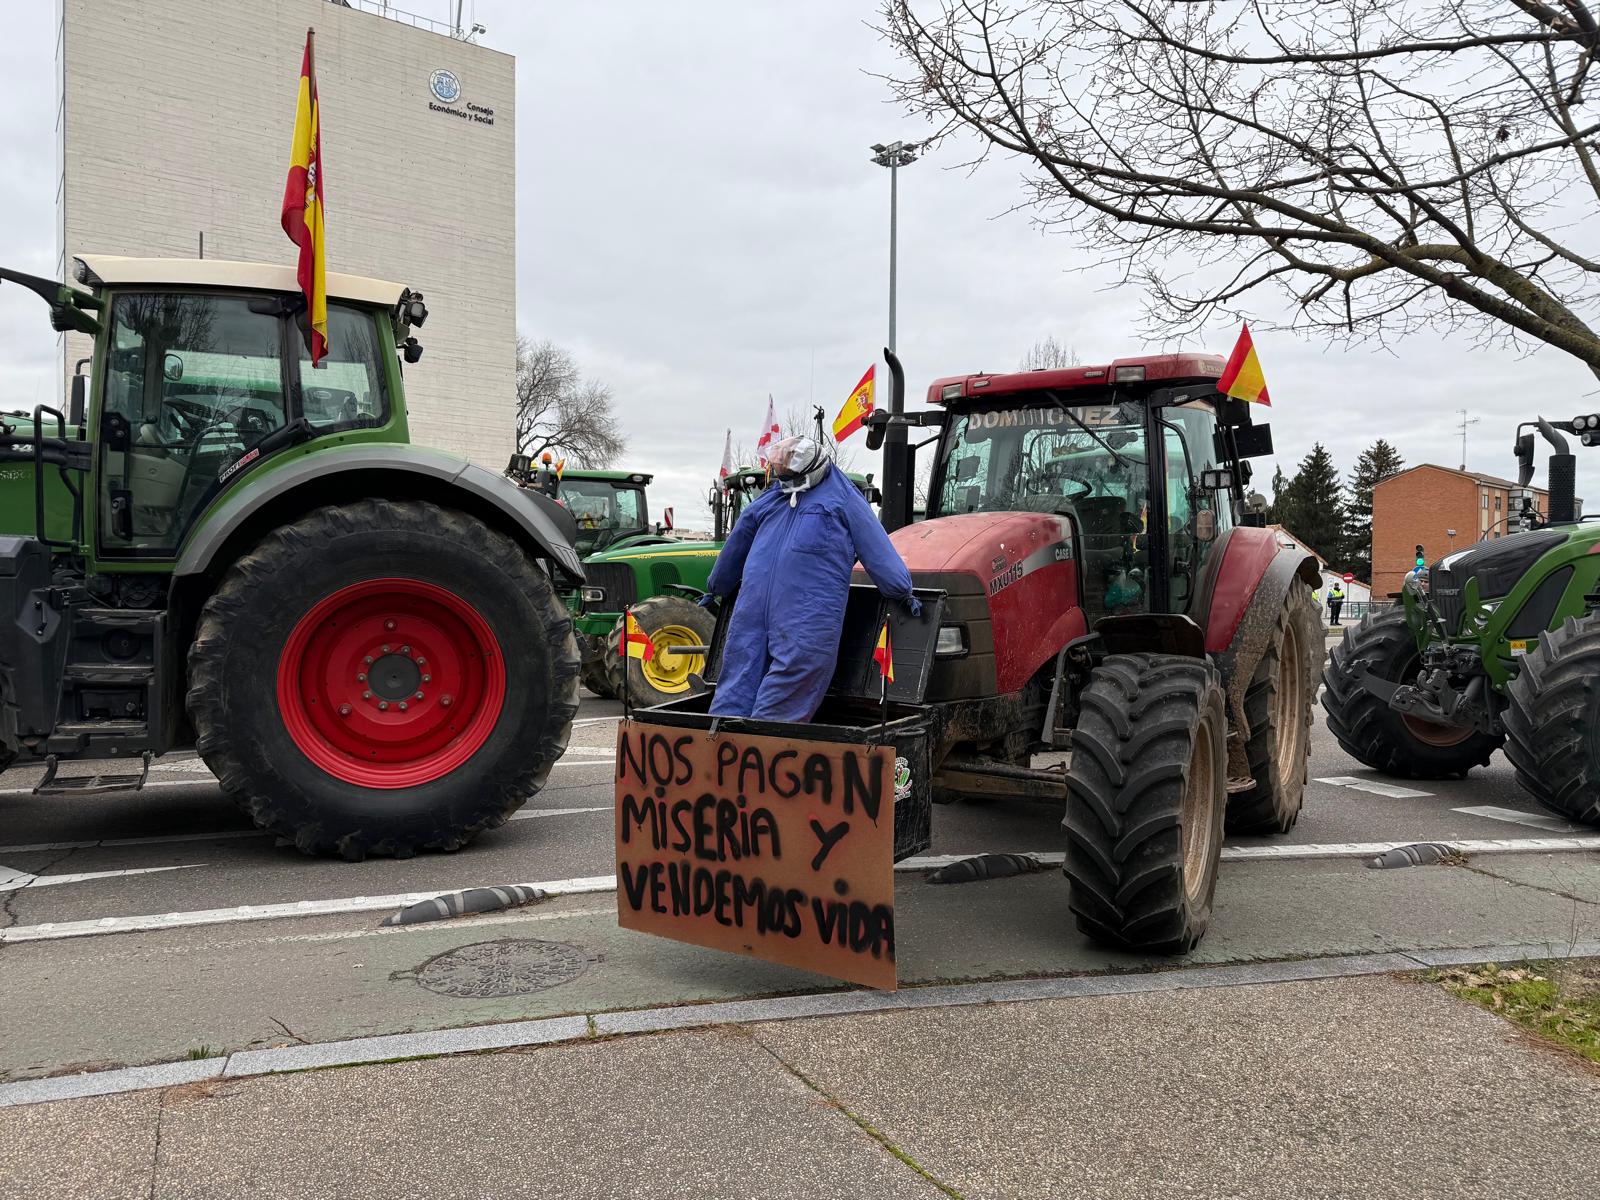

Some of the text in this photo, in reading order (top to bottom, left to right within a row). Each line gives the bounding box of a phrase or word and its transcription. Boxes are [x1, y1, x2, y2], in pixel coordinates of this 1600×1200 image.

[428, 102, 468, 119] Económico
[474, 114, 494, 125] Social
[466, 102, 493, 116] Consejo
[989, 560, 1023, 596] MXU115
[619, 731, 884, 824] NOS PAGAN
[809, 819, 850, 871] Y
[620, 861, 808, 938] VENDEMOS
